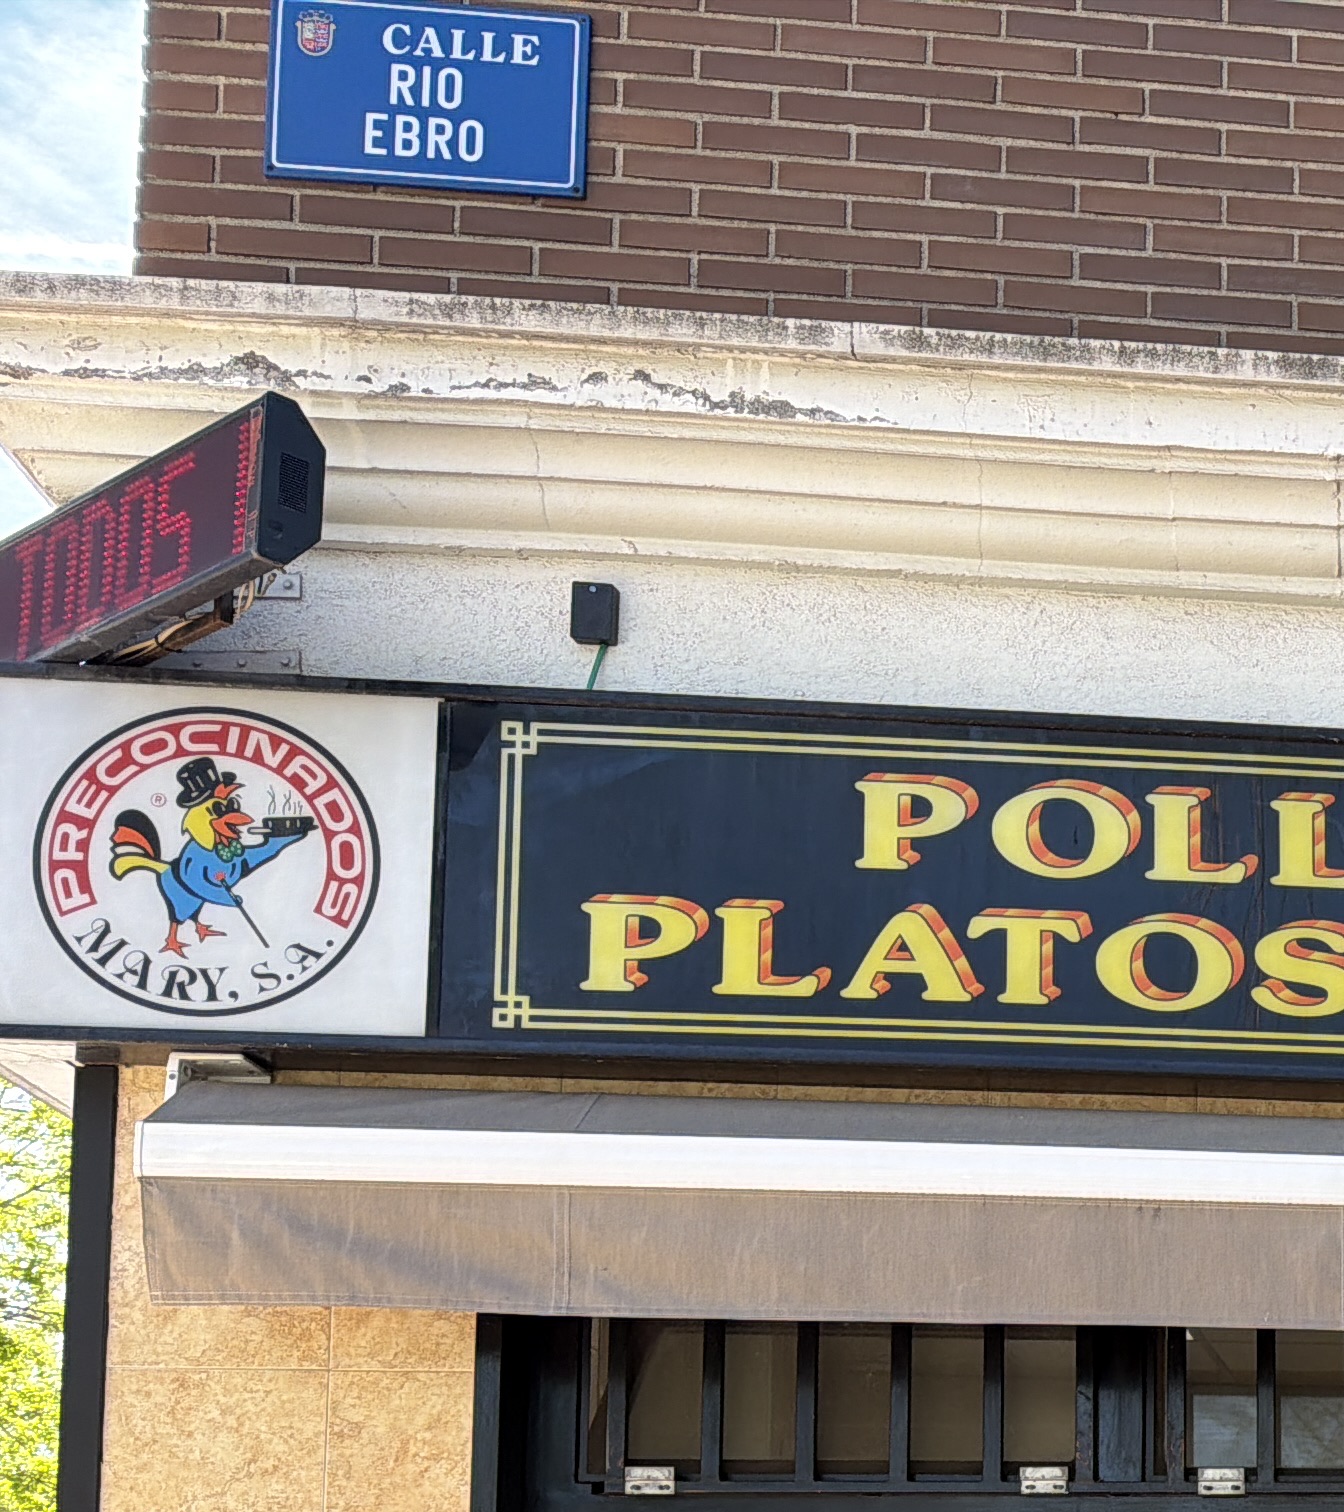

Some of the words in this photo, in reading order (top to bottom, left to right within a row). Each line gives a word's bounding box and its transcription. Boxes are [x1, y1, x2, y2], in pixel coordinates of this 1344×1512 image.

[382, 23, 541, 67] CALLE
[388, 63, 464, 110] RIO
[363, 112, 486, 163] EBRO
[49, 721, 364, 929] PRECOCINADOS
[73, 916, 240, 1004] MARY,
[256, 937, 337, 990] S.A.
